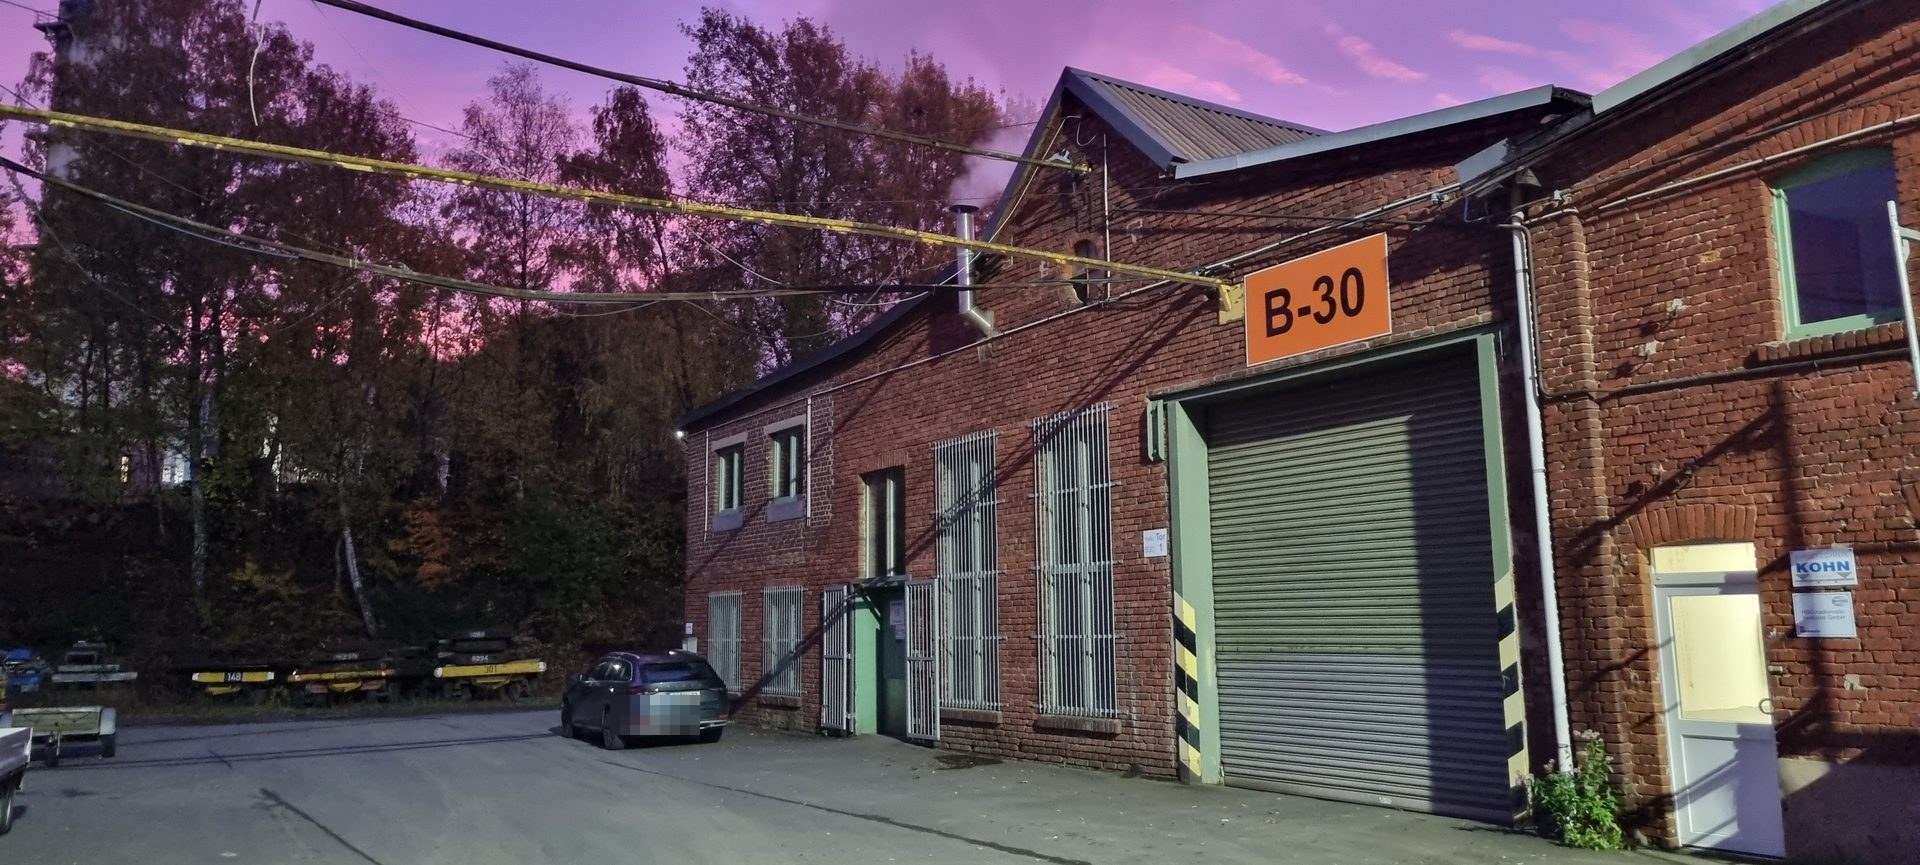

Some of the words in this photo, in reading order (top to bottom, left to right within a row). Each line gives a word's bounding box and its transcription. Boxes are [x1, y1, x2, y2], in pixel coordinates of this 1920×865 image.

[1264, 266, 1365, 338] B-30
[1155, 532, 1166, 541] Tor
[1796, 560, 1850, 573] KOHN
[227, 672, 242, 682] 148
